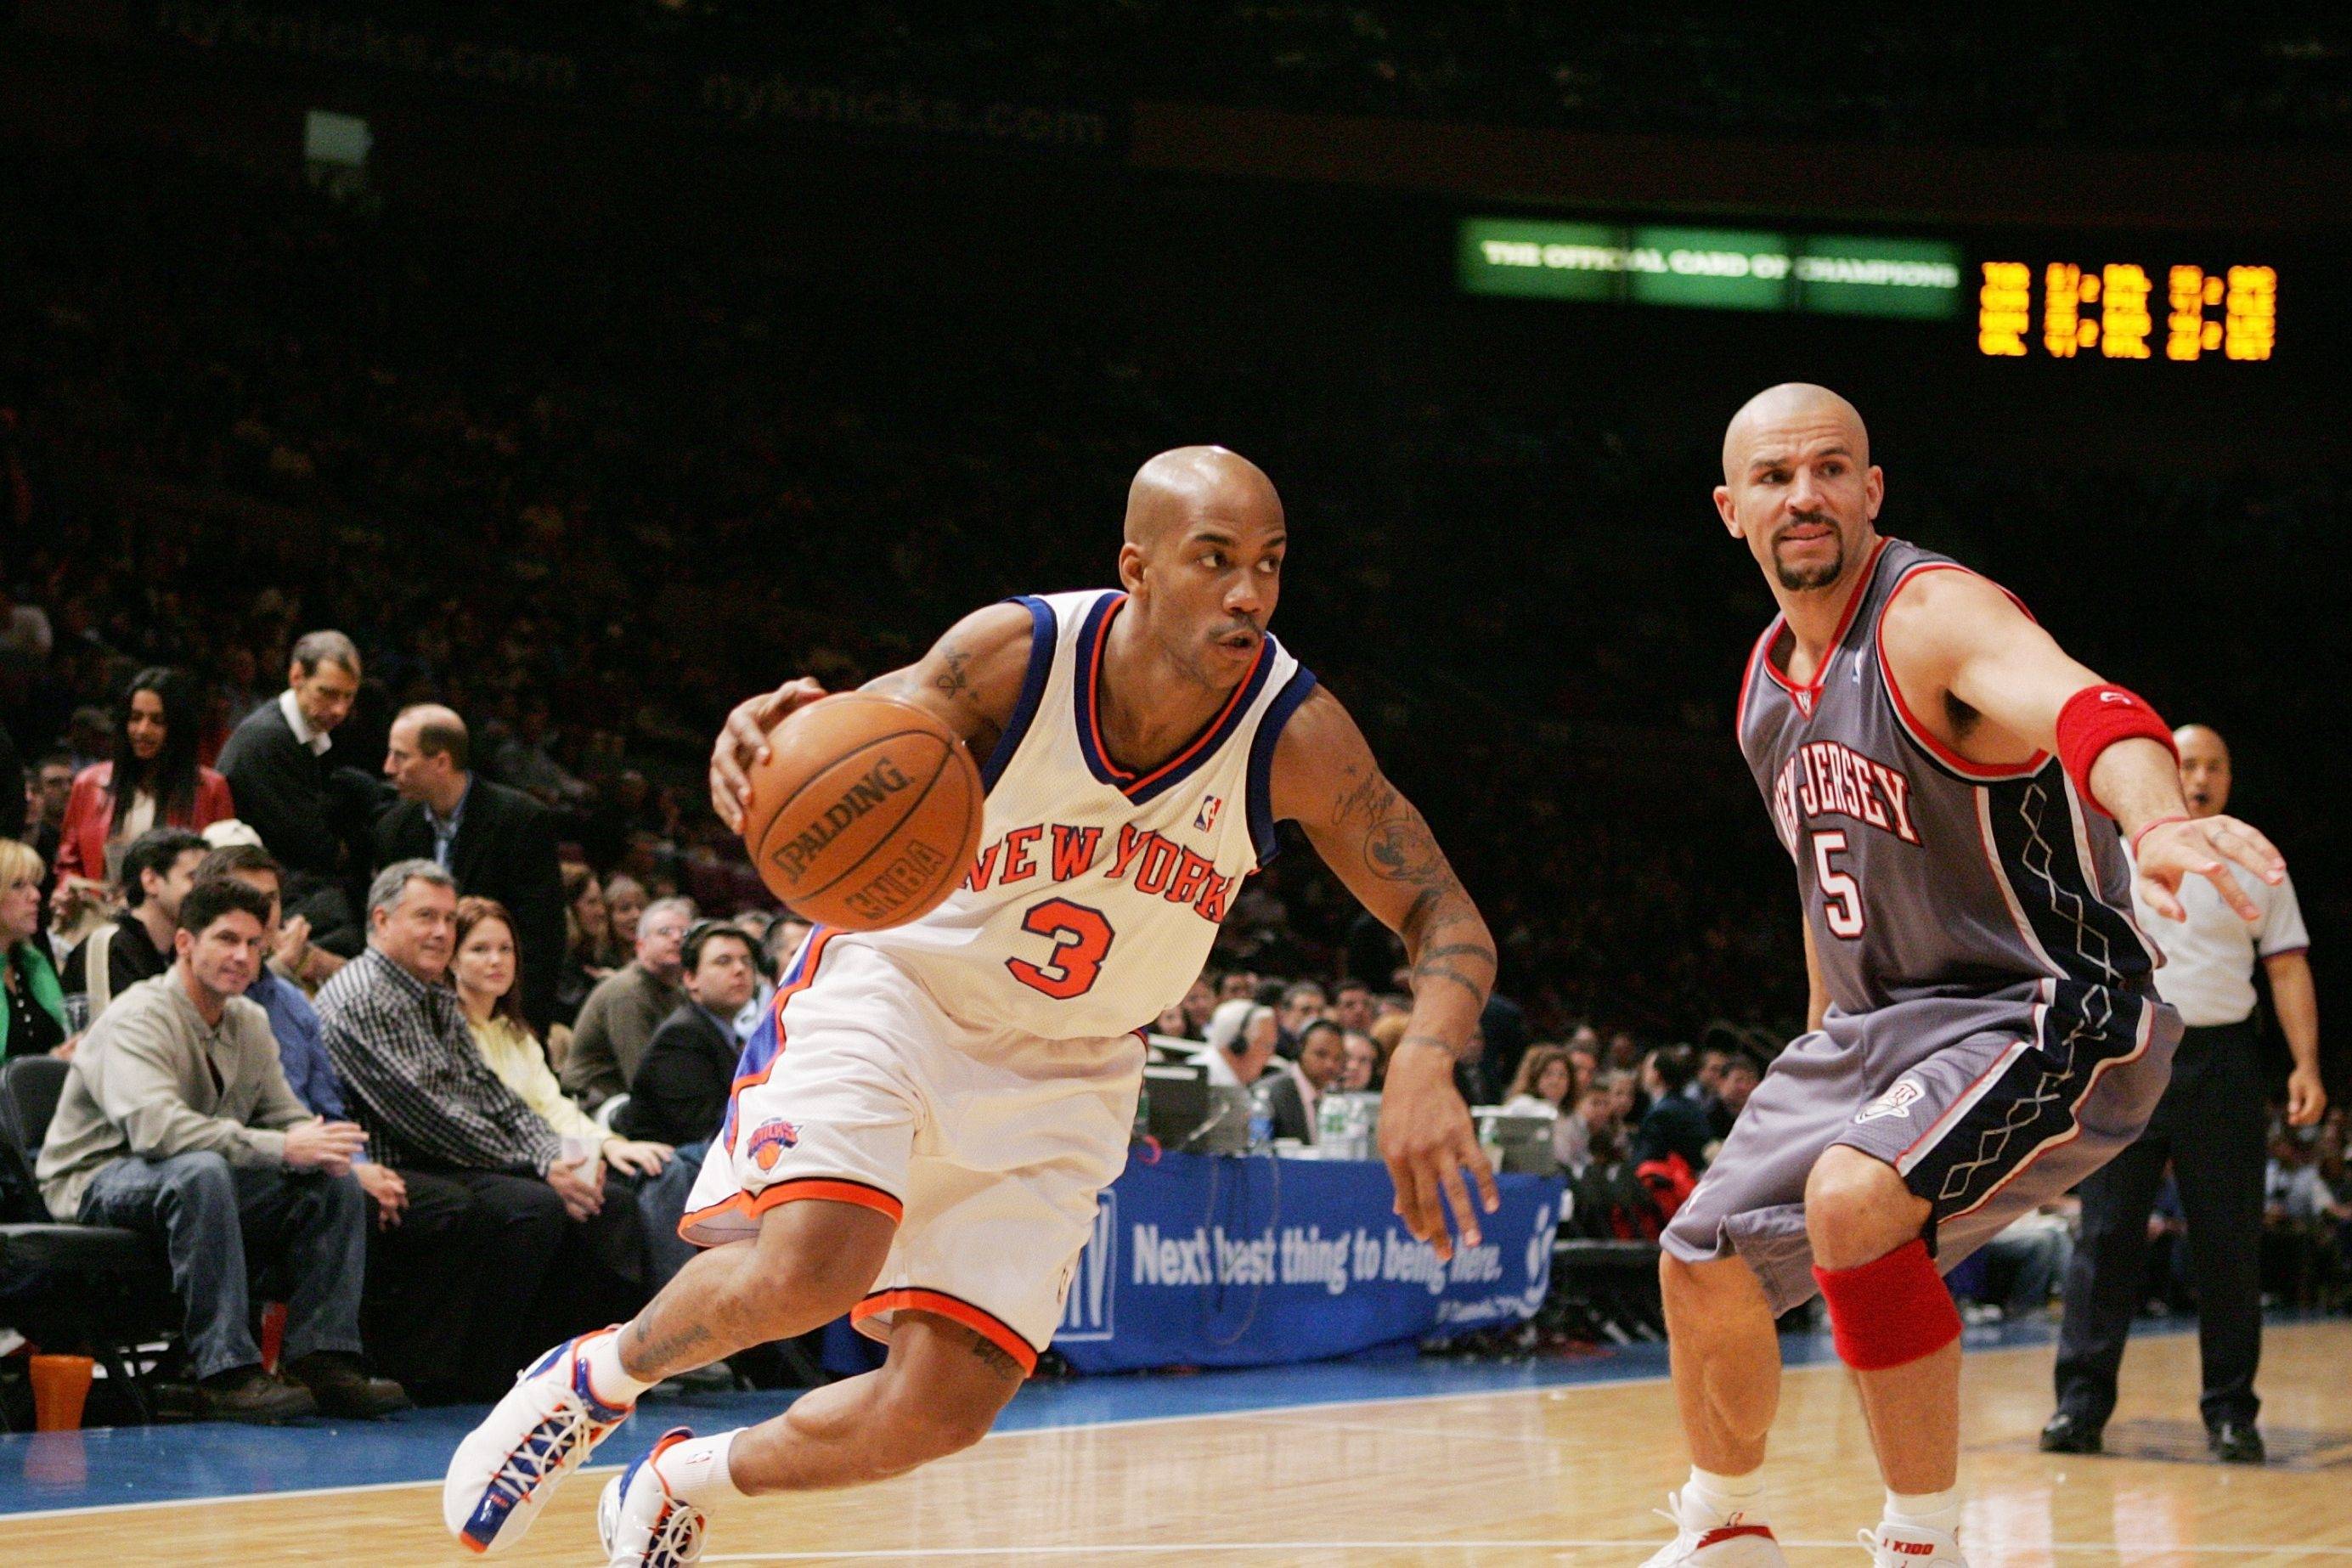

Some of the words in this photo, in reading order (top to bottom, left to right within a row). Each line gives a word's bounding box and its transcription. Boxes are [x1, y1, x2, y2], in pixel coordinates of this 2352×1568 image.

[770, 756, 915, 884] SPALDING
[1799, 740, 1922, 848] JERSEY
[1104, 822, 1235, 924] YORK
[1811, 828, 1866, 939] 5
[1005, 897, 1115, 1000] 3
[1133, 1224, 1212, 1285] Next
[1215, 1227, 1275, 1285] best
[1281, 1226, 1351, 1294] thing
[1354, 1230, 1380, 1281] to
